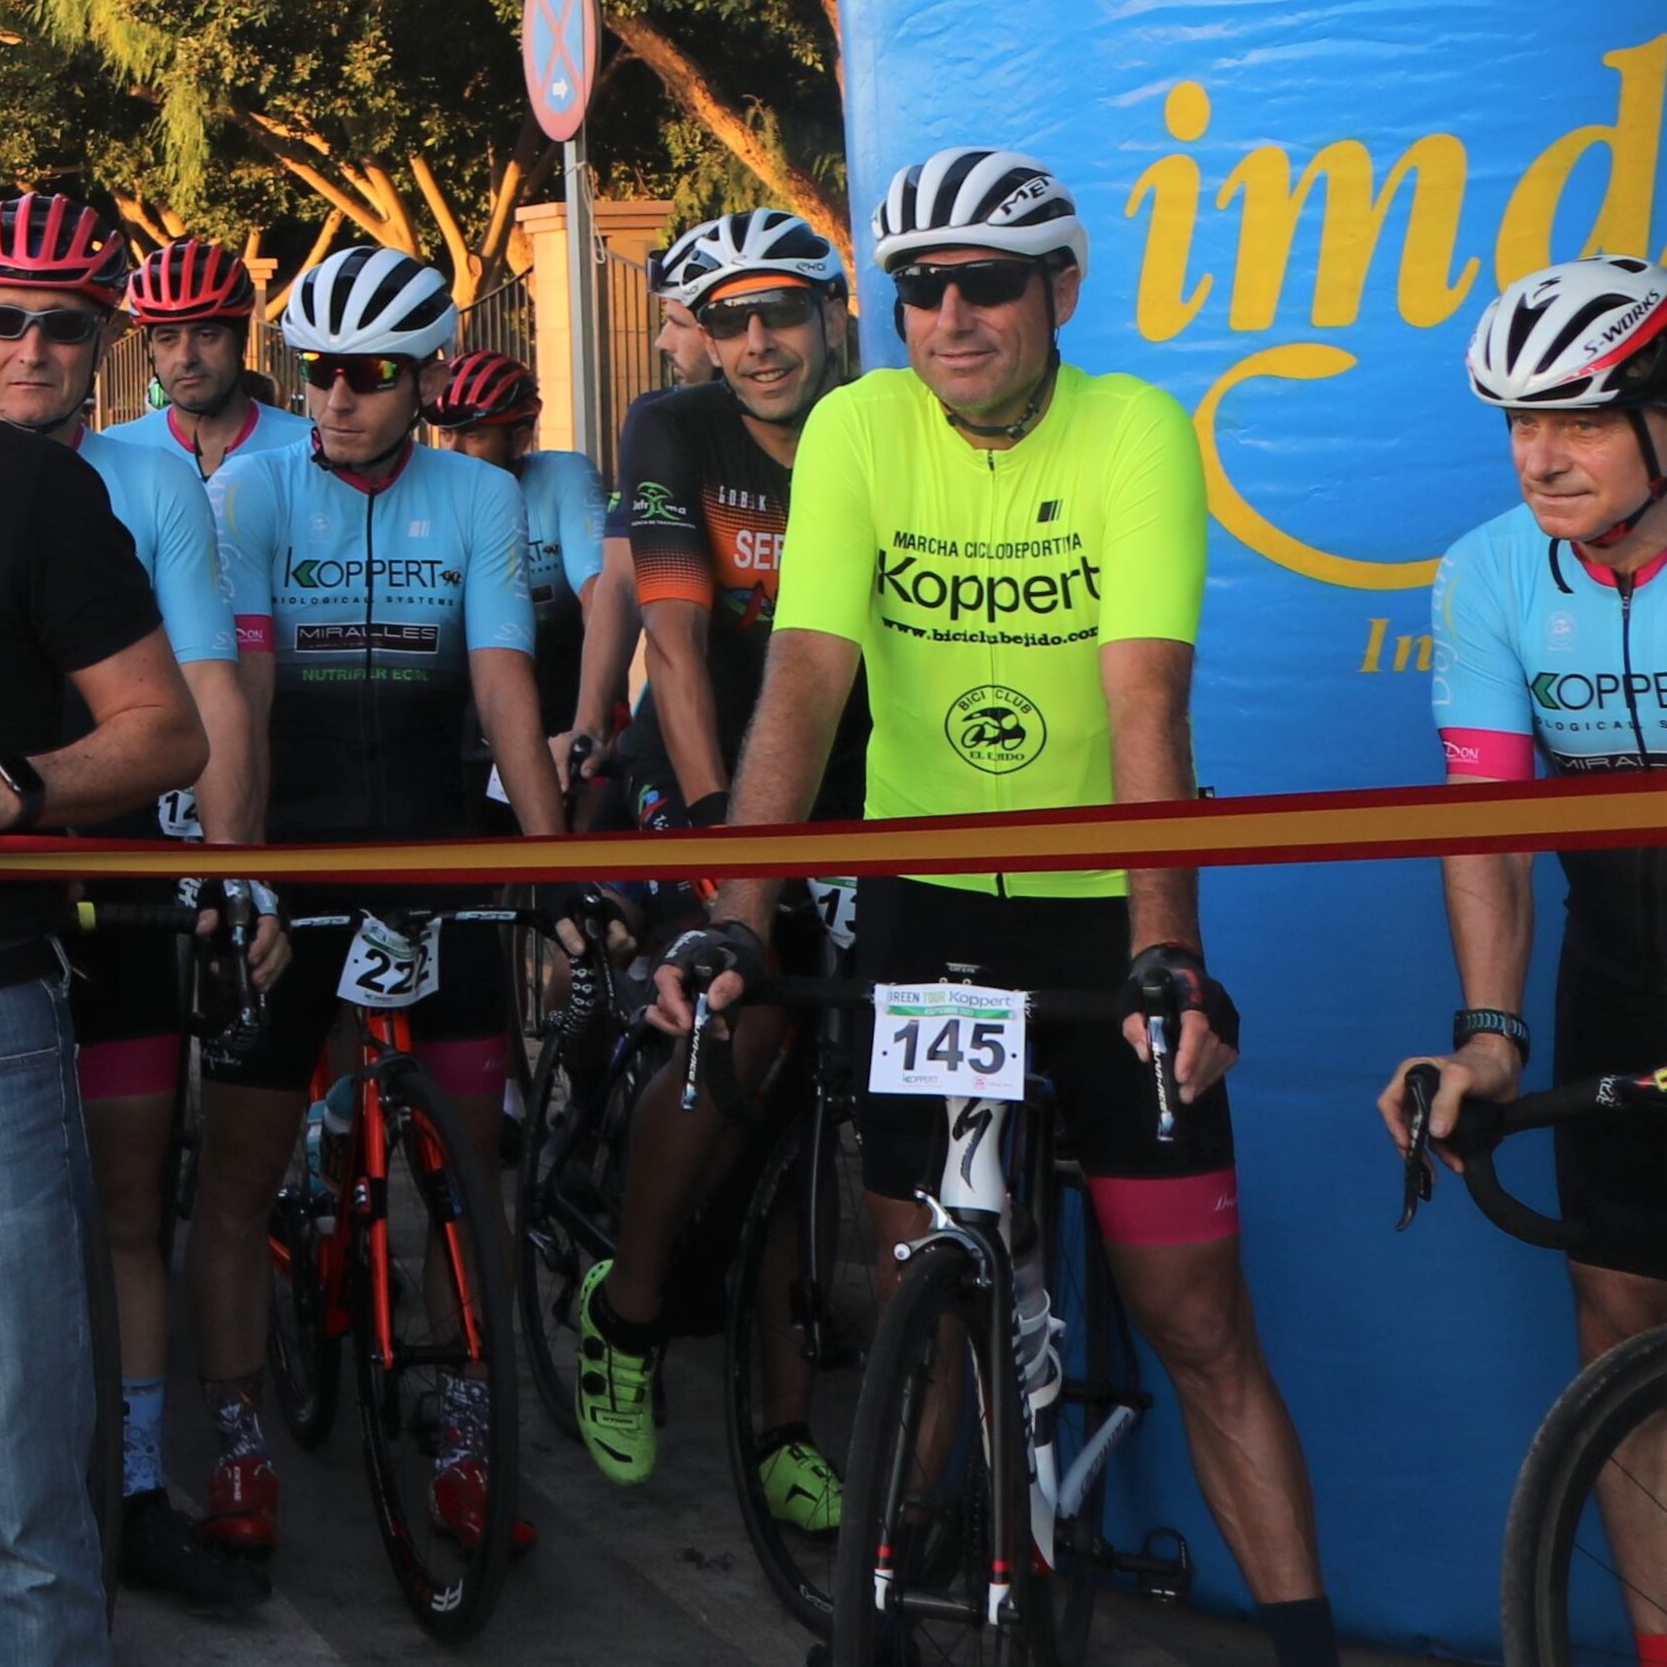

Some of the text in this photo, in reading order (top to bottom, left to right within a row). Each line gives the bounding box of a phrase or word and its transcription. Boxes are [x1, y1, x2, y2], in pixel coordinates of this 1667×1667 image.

[1126, 35, 1667, 342] imd
[1583, 288, 1660, 359] S-WORKS
[893, 530, 1083, 560] MARCHA CICLODEPORTIVA
[284, 546, 444, 589] KOPPERT
[271, 595, 455, 607] BIOLOGICAL SYSTEMS
[877, 549, 1101, 623] Koppert
[299, 625, 437, 641] MIRALLES
[302, 668, 388, 682] NUTRIFER
[1531, 671, 1667, 711] KOPPE
[957, 688, 1033, 715] BICI CLUB
[948, 990, 1012, 1007] Koppert
[893, 1019, 1006, 1075] 145
